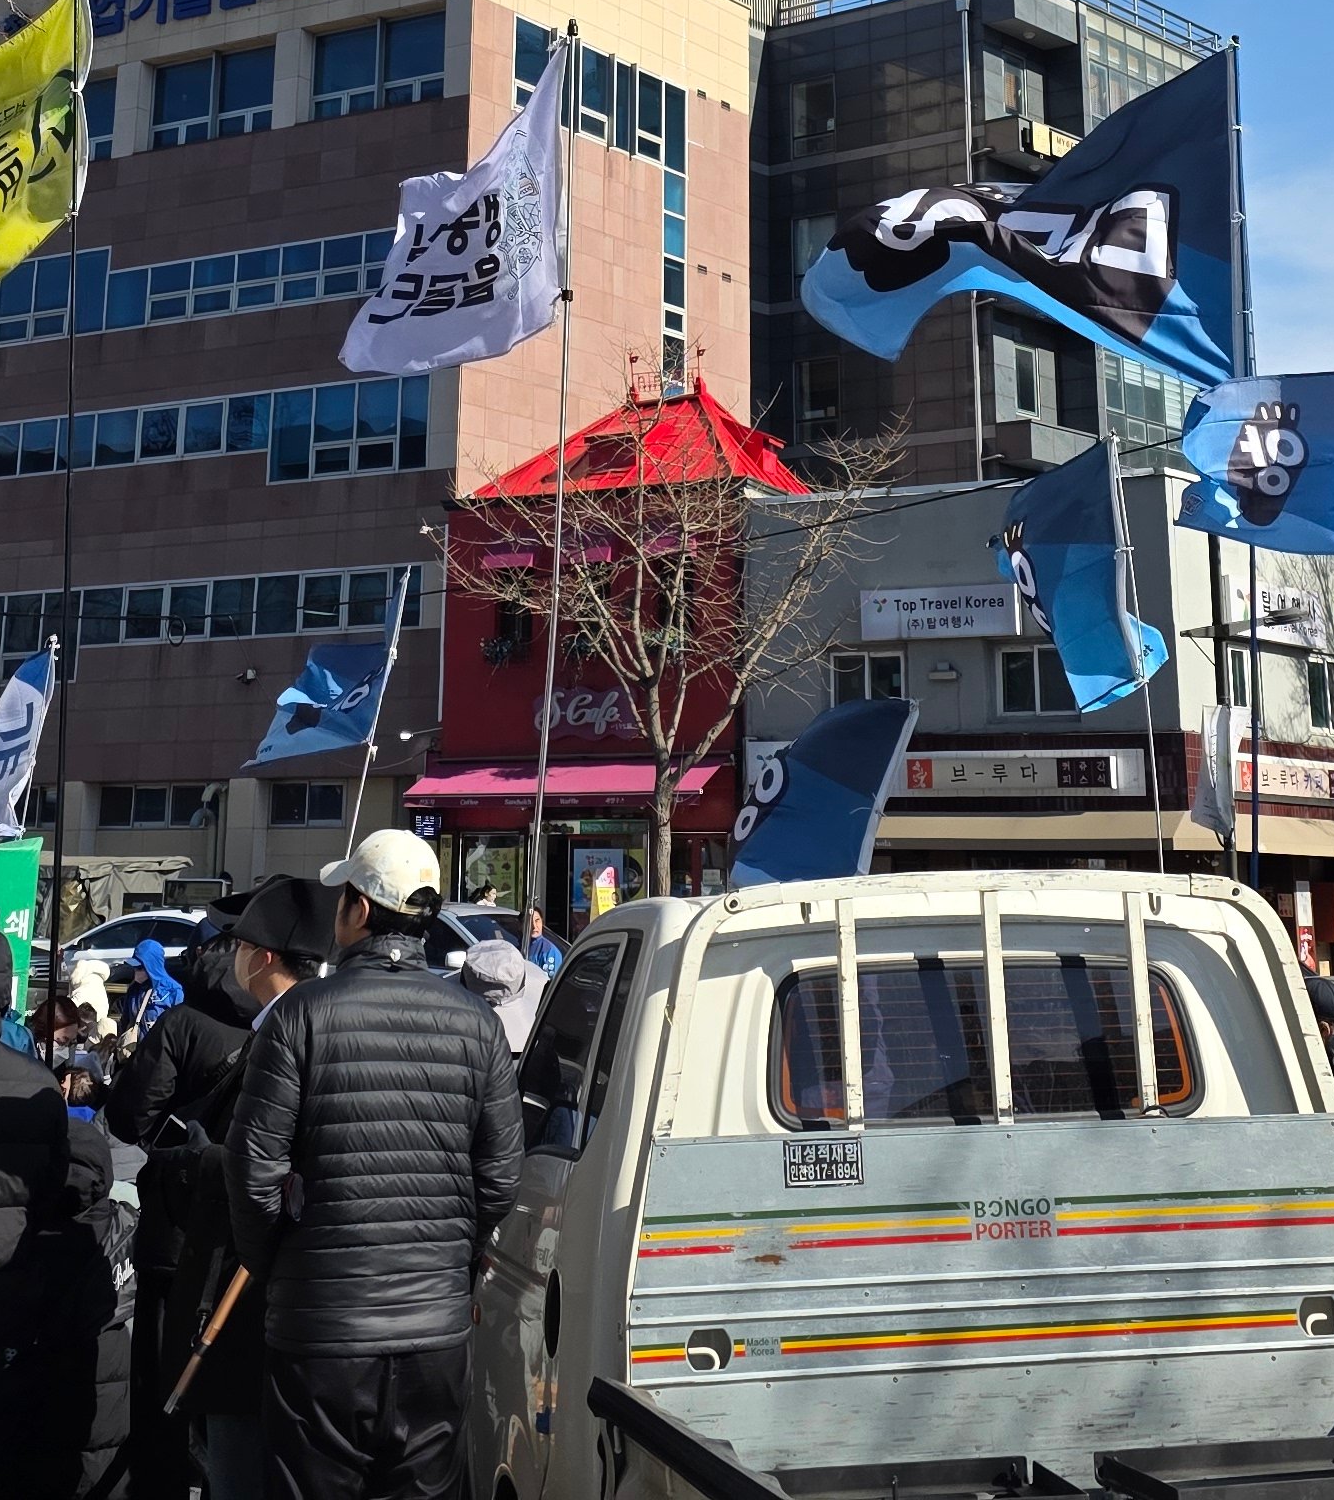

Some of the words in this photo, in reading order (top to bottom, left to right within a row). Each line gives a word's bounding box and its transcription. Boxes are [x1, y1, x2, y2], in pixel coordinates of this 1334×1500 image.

[894, 599, 916, 614] Top
[920, 596, 961, 611] Travel
[965, 596, 1005, 608] Korea
[789, 1143, 858, 1164] 대성적재함
[974, 1197, 1051, 1218] BONGO
[975, 1220, 1052, 1240] PORTER
[747, 1337, 770, 1347] Made
[772, 1337, 779, 1346] in
[751, 1347, 775, 1357] Korea
